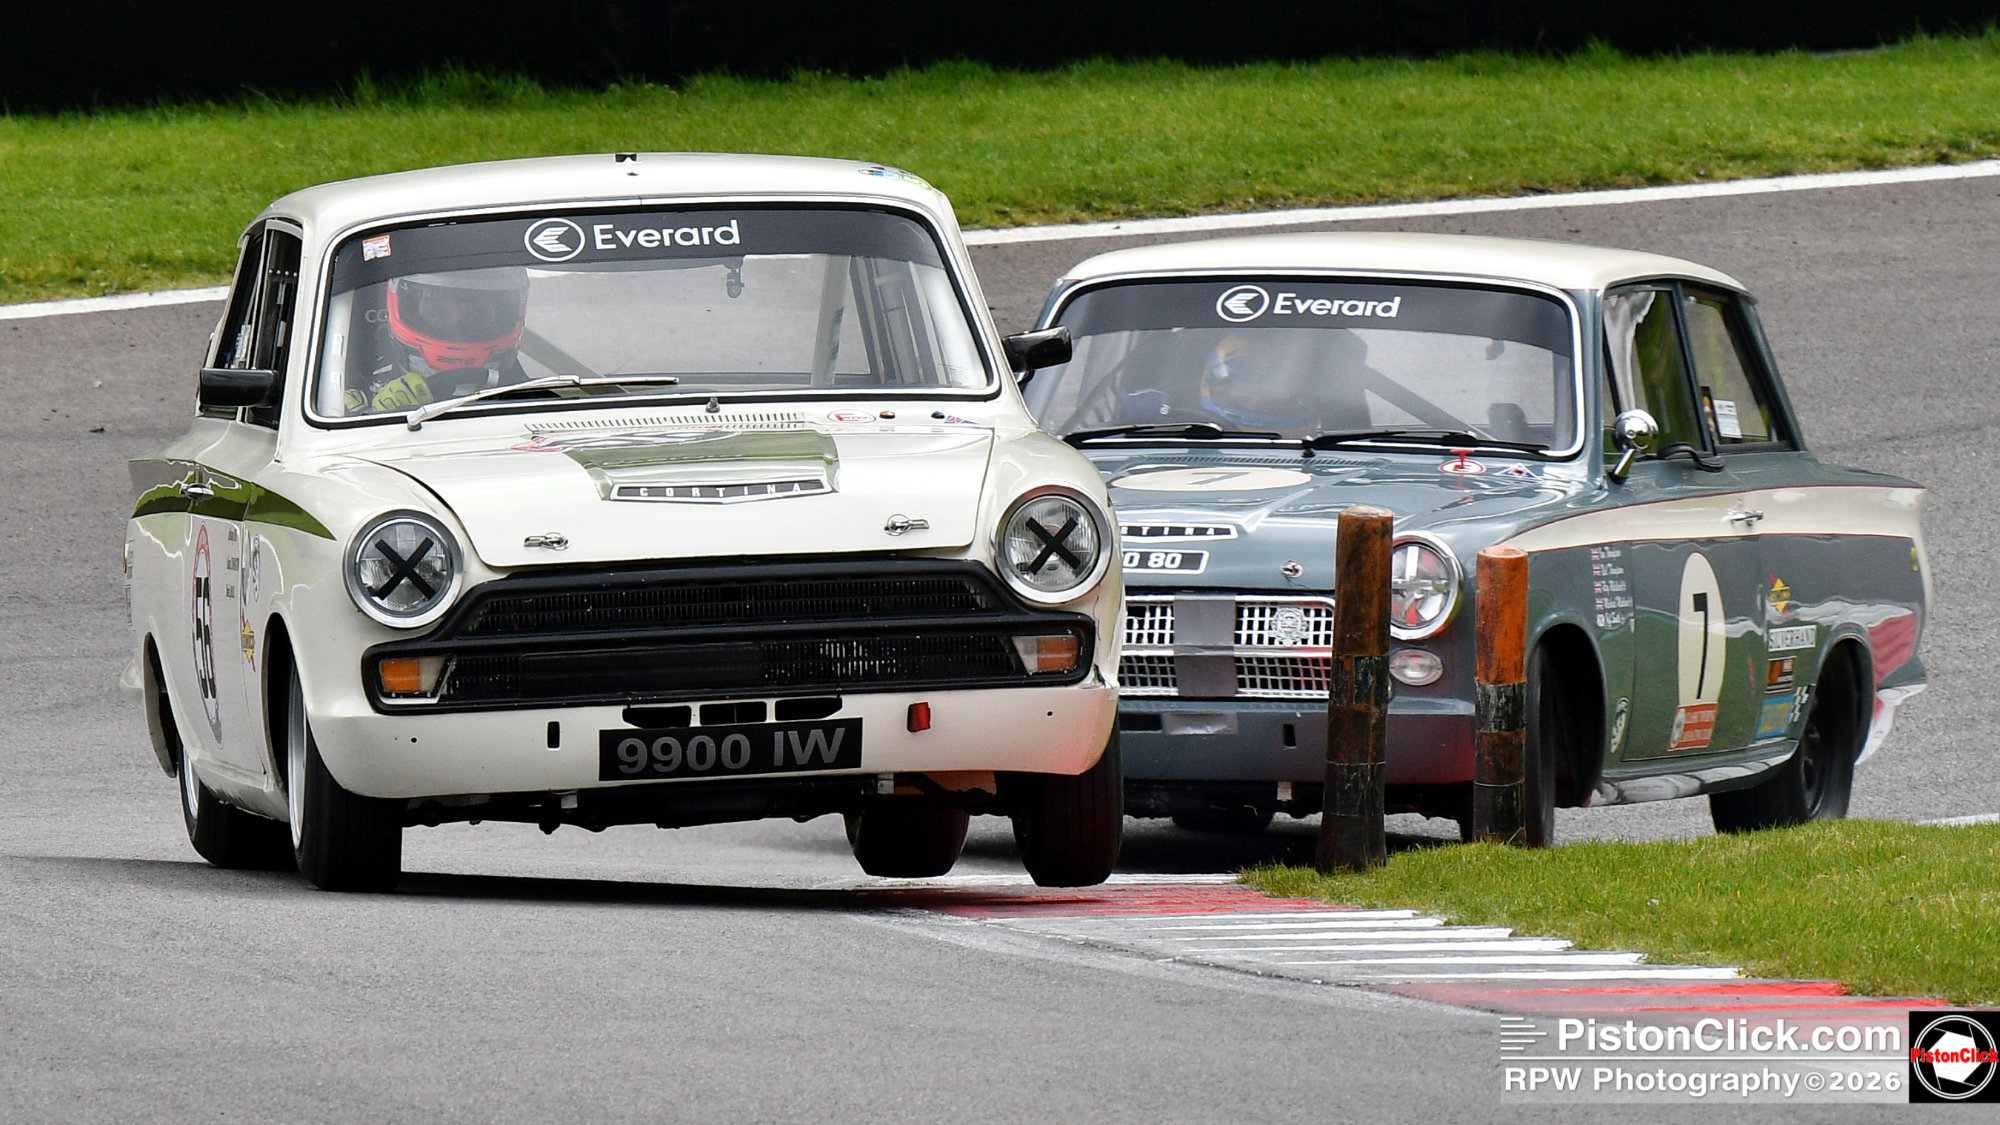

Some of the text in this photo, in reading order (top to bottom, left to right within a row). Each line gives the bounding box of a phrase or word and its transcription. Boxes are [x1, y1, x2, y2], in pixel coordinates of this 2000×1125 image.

[594, 219, 741, 251] Everard
[1272, 293, 1401, 319] Everard
[1186, 471, 1251, 485] 7
[639, 482, 801, 498] CORTINA
[1121, 526, 1214, 536] RTINA
[1147, 552, 1182, 569] 80
[1692, 592, 1708, 700] 7
[617, 727, 845, 774] 9900 IW
